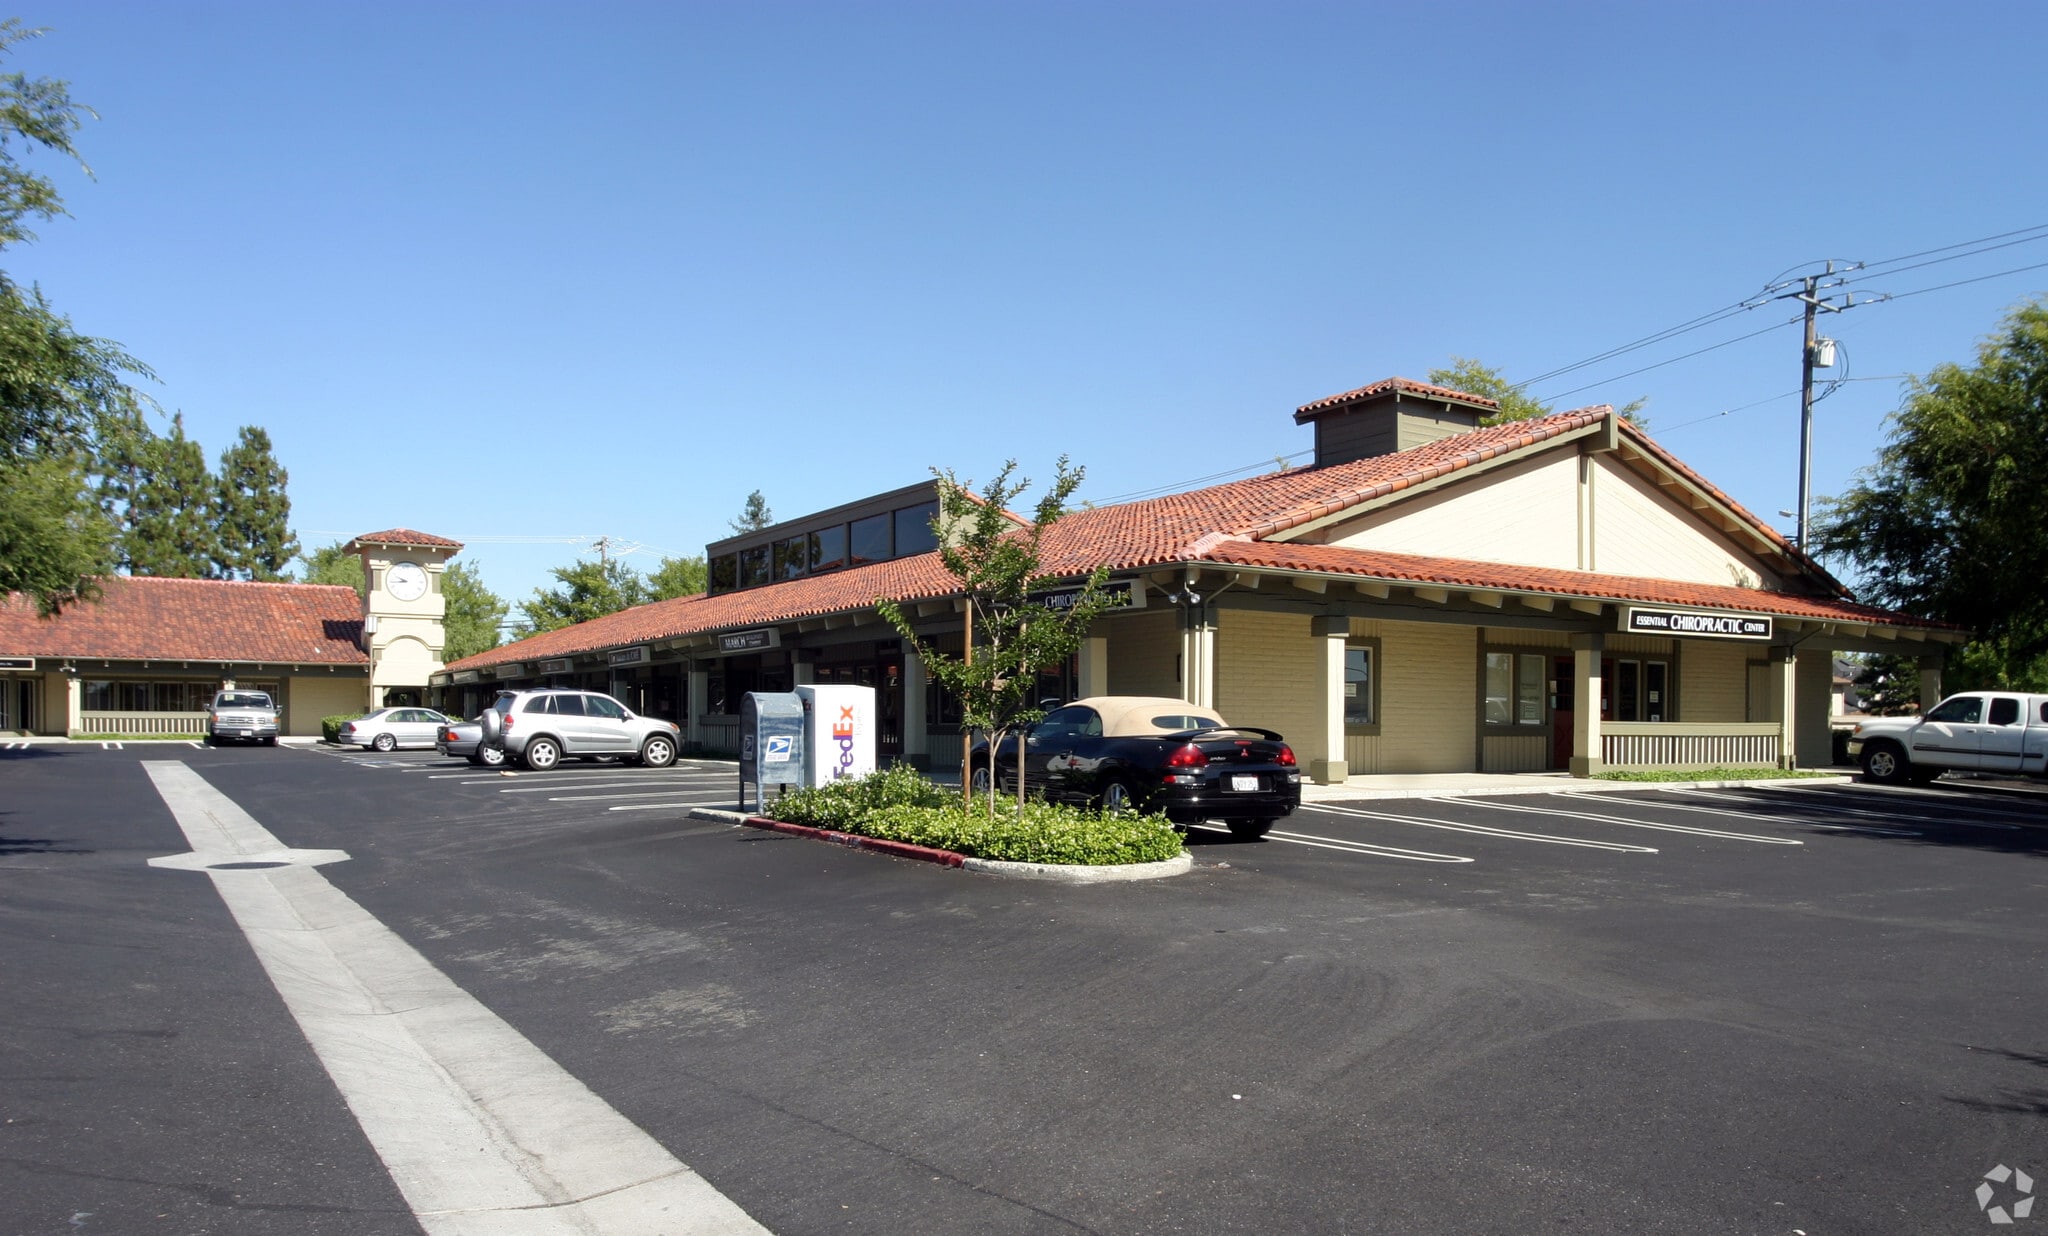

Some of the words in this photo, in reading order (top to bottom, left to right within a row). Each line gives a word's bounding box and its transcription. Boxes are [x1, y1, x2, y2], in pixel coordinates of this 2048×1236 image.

[1636, 615, 1668, 627] ESSENTIAL
[1670, 614, 1743, 633] CHIROPRACTIC
[1744, 622, 1765, 632] CENTER
[833, 705, 854, 779] FedEx
